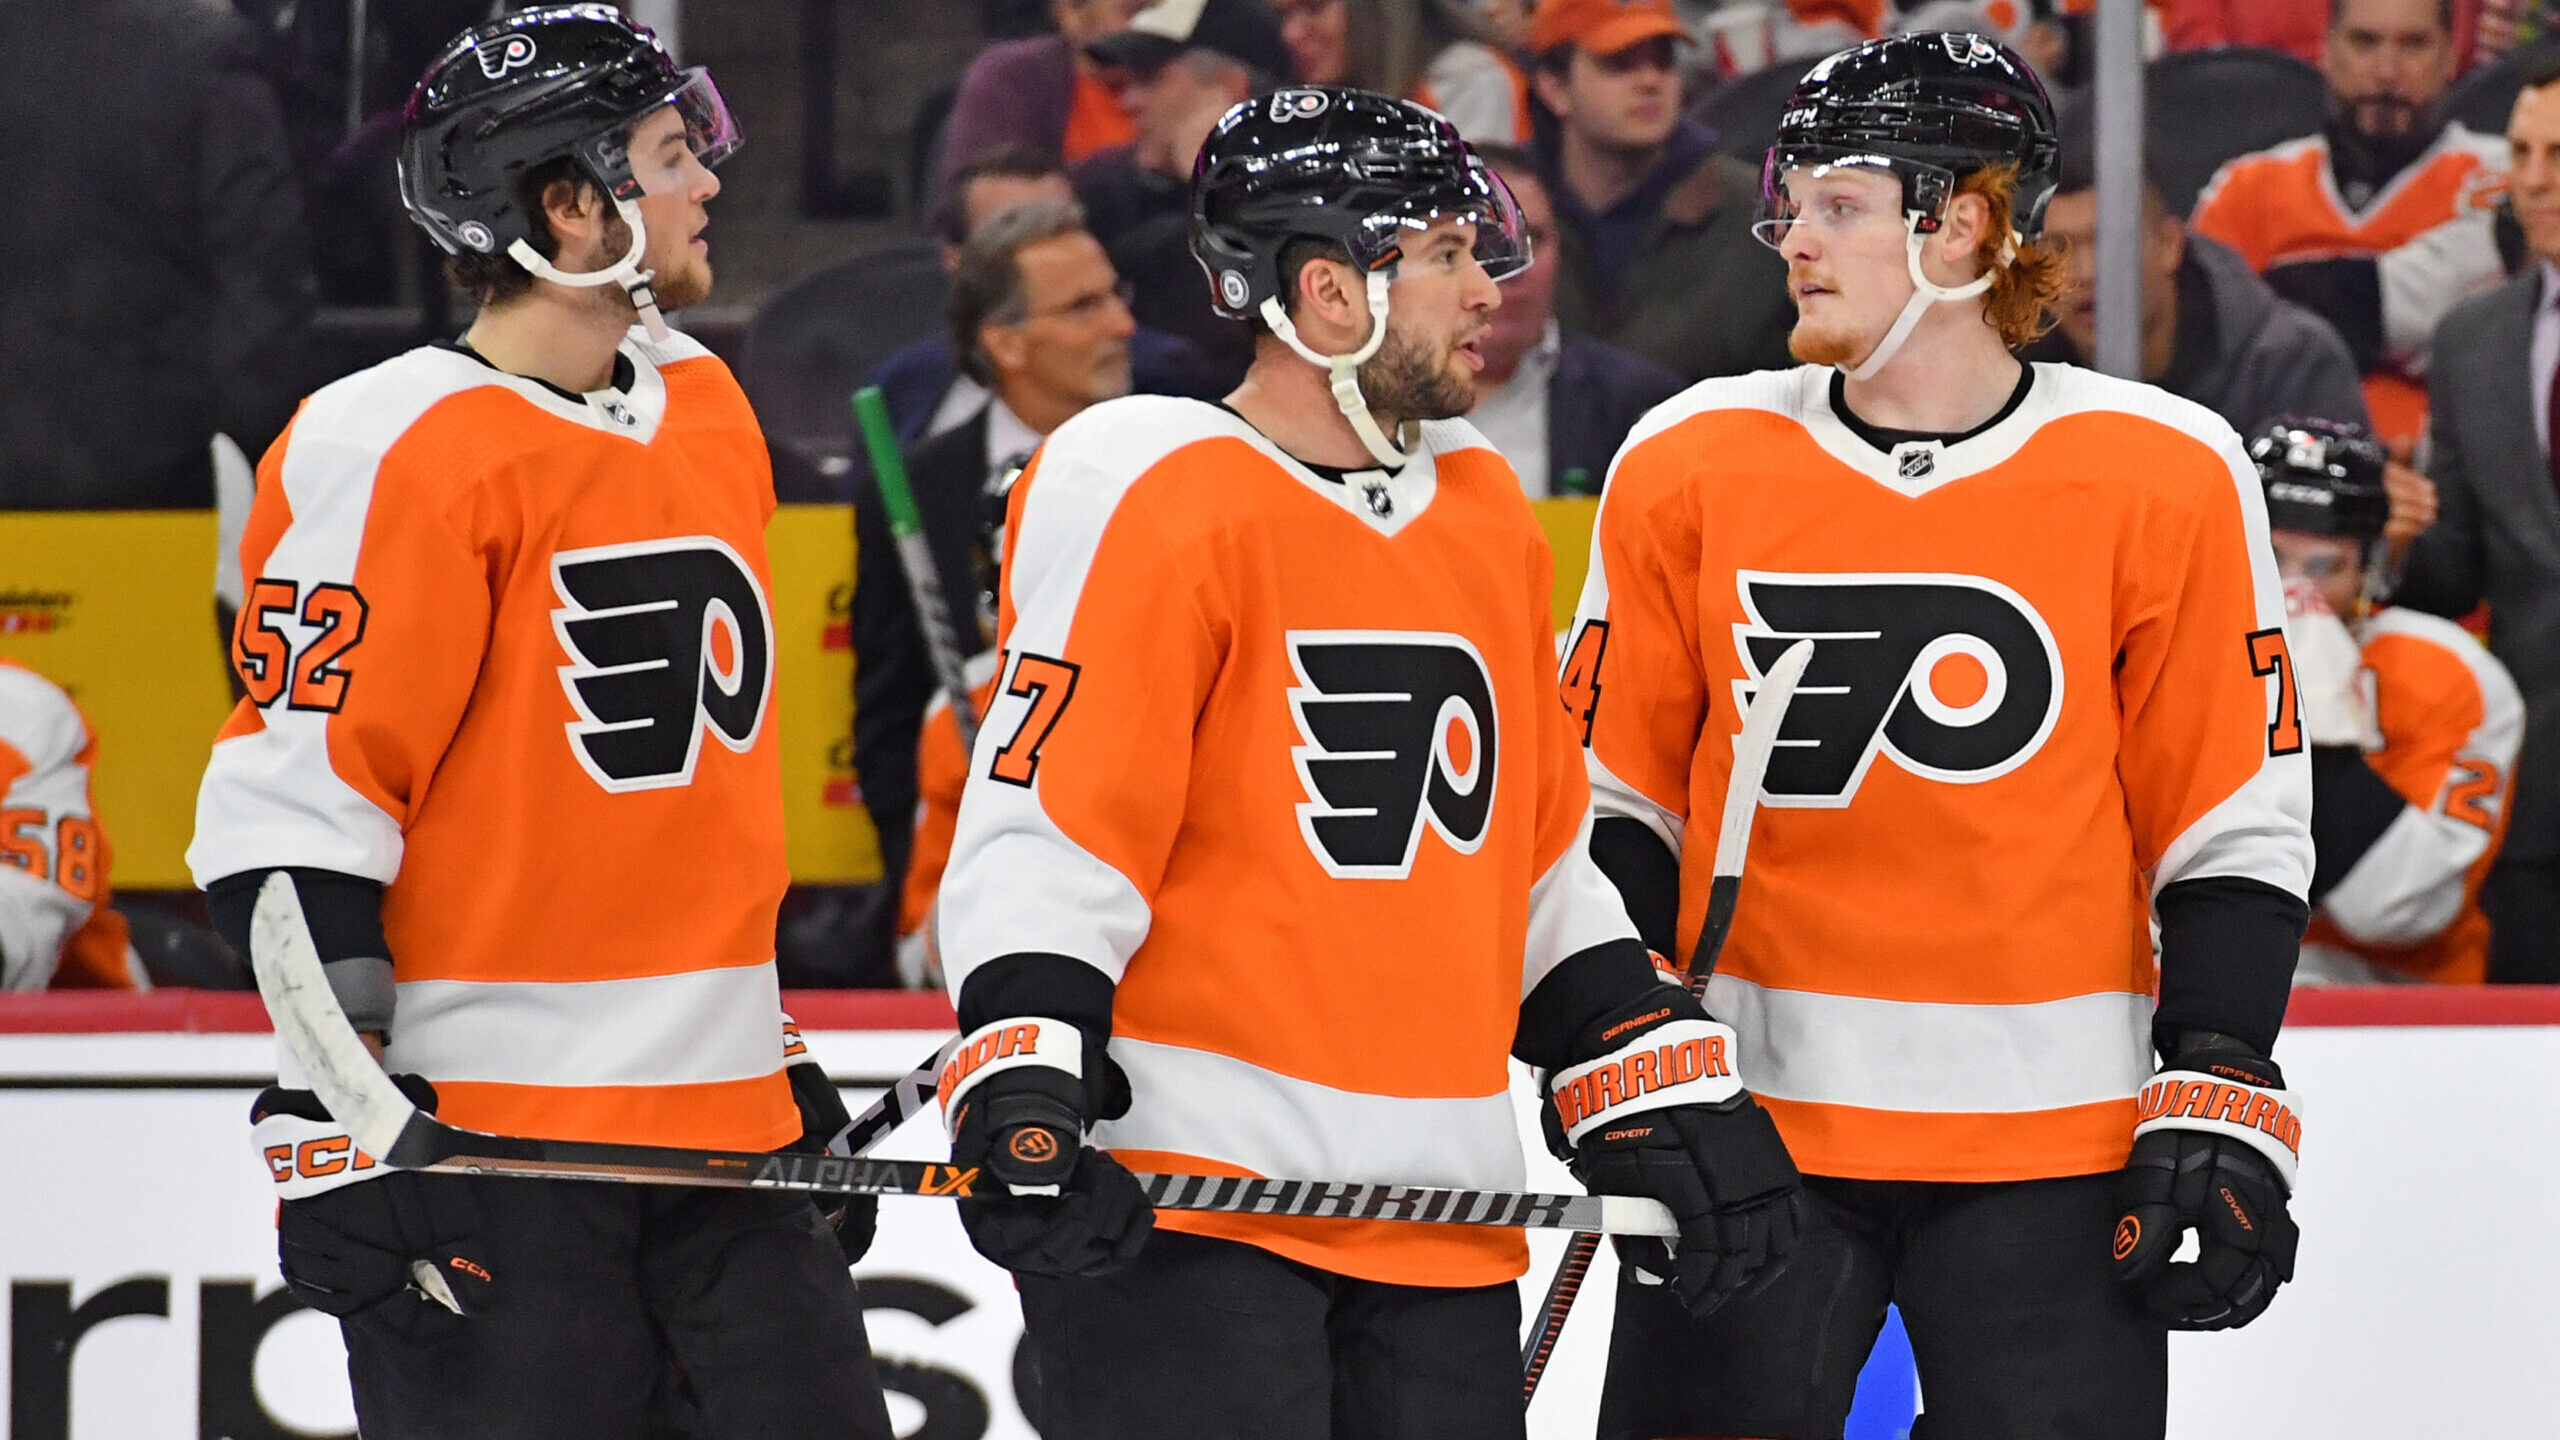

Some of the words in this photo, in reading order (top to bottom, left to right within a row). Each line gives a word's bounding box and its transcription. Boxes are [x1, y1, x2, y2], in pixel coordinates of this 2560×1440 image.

[1781, 106, 1819, 129] CCM
[239, 578, 369, 714] 52
[1558, 616, 1610, 749] 4
[2245, 627, 2306, 758] 7
[980, 649, 1082, 789] 7
[0, 806, 98, 902] 58
[1553, 1035, 1731, 1135] WARRIOR
[1604, 1127, 1653, 1141] COVERT
[2137, 1079, 2303, 1162] WARRIO
[751, 1155, 903, 1193] ALPHA
[918, 1165, 979, 1197] LX
